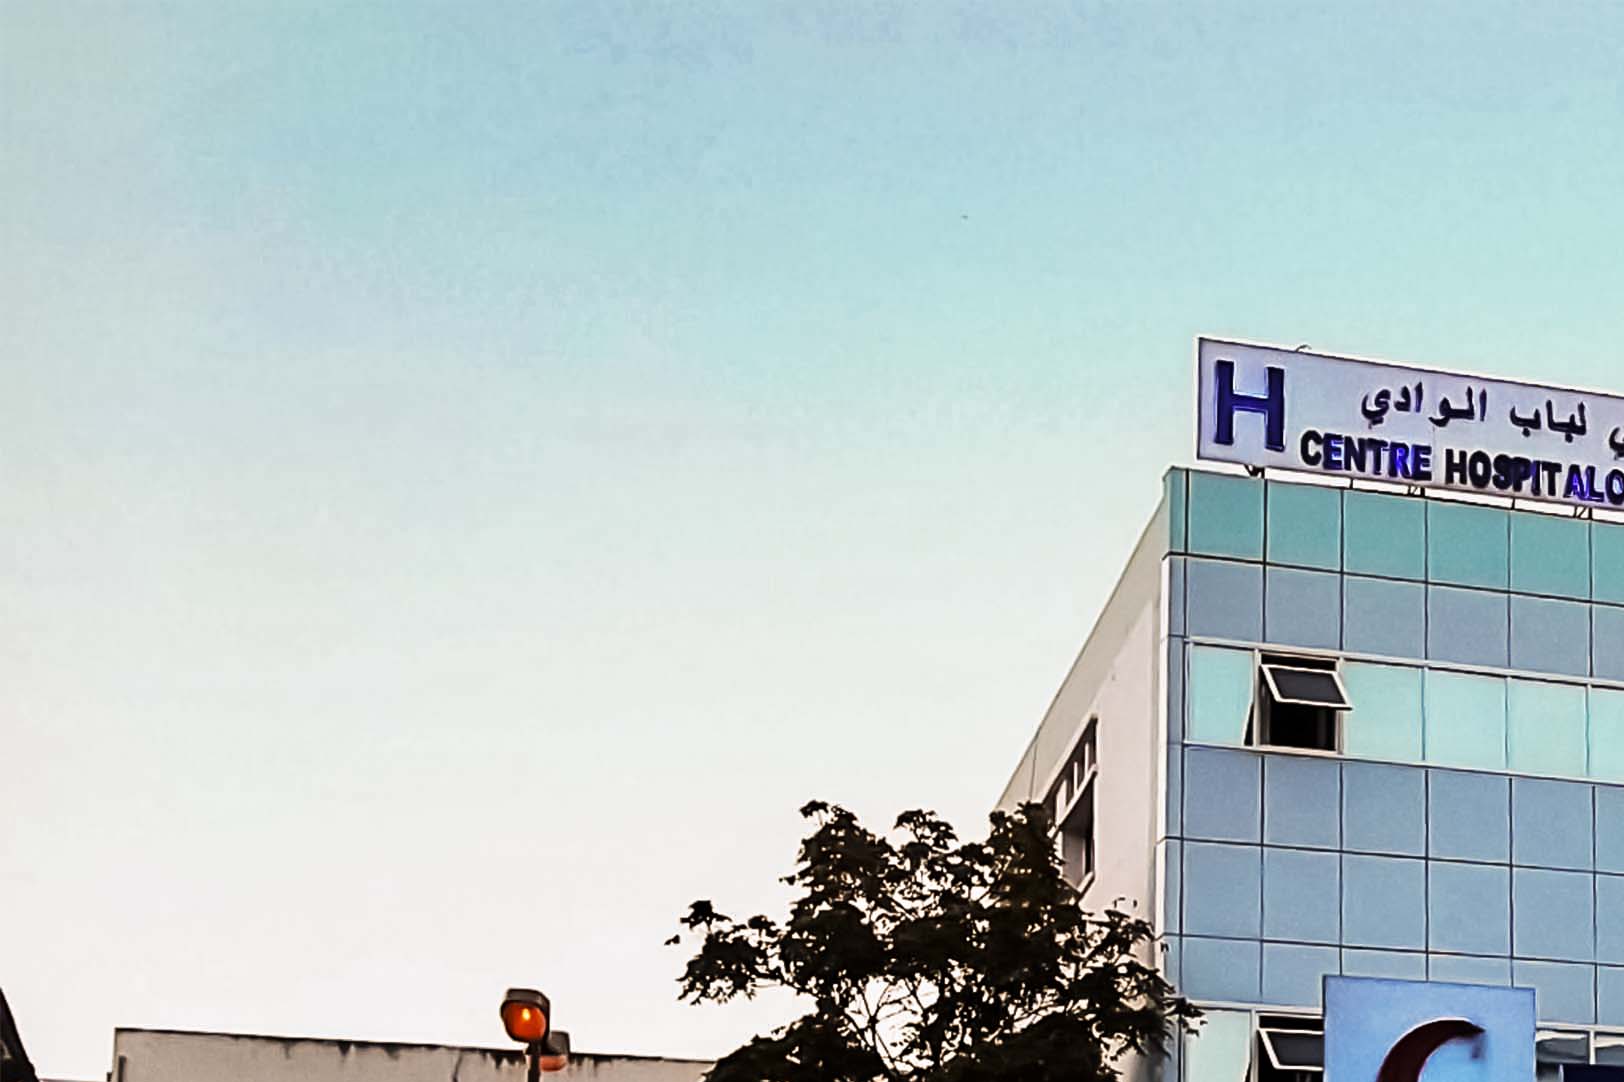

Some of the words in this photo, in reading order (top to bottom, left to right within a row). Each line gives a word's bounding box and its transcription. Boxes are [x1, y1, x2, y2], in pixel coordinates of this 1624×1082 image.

[1213, 359, 1286, 453] H
[1360, 381, 1488, 431] الوادي
[1509, 399, 1587, 437] لباب
[1298, 429, 1433, 482] CENTRE
